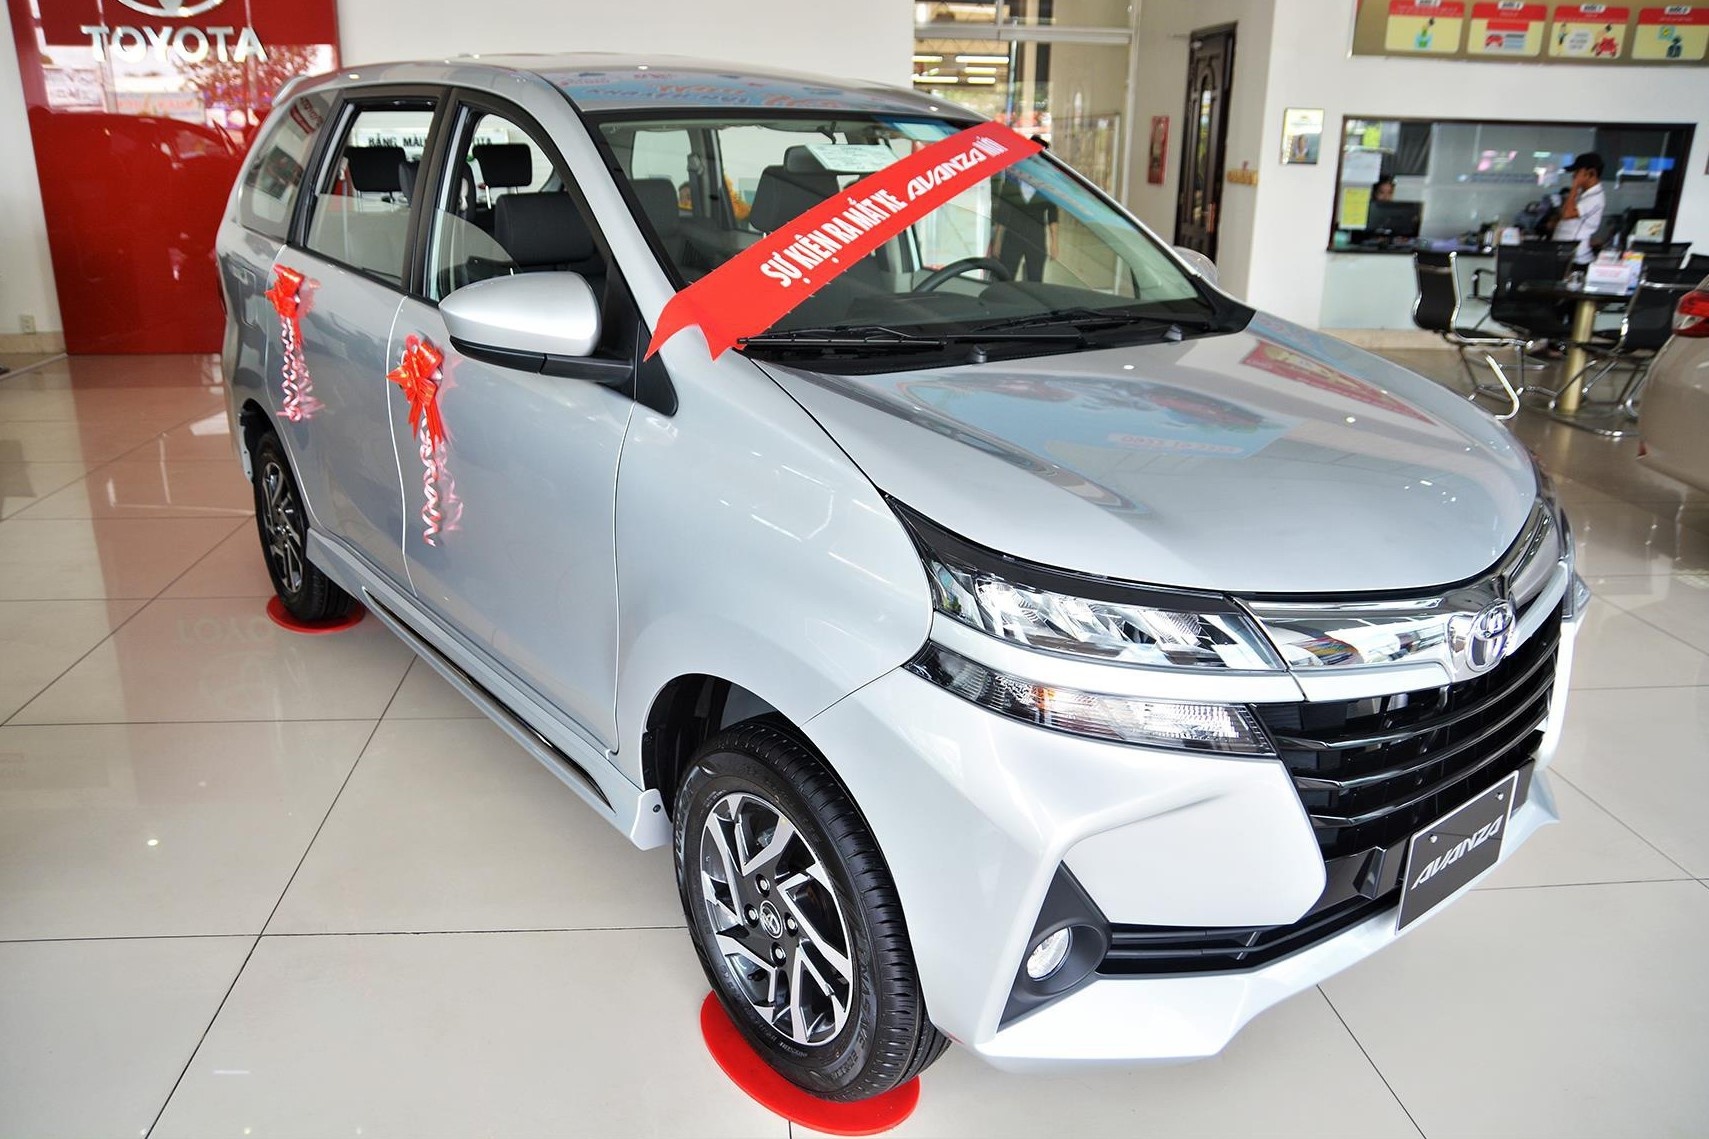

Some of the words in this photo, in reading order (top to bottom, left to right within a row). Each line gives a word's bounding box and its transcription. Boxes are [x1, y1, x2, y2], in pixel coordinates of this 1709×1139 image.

[80, 25, 269, 63] TOYOTA
[906, 147, 987, 201] AVANZA
[842, 197, 891, 231] MẮT
[870, 189, 908, 213] XE
[821, 217, 864, 244] RA
[760, 251, 811, 288] SỰ
[783, 234, 843, 270] KIỆN
[1411, 814, 1504, 890] AVANZA
